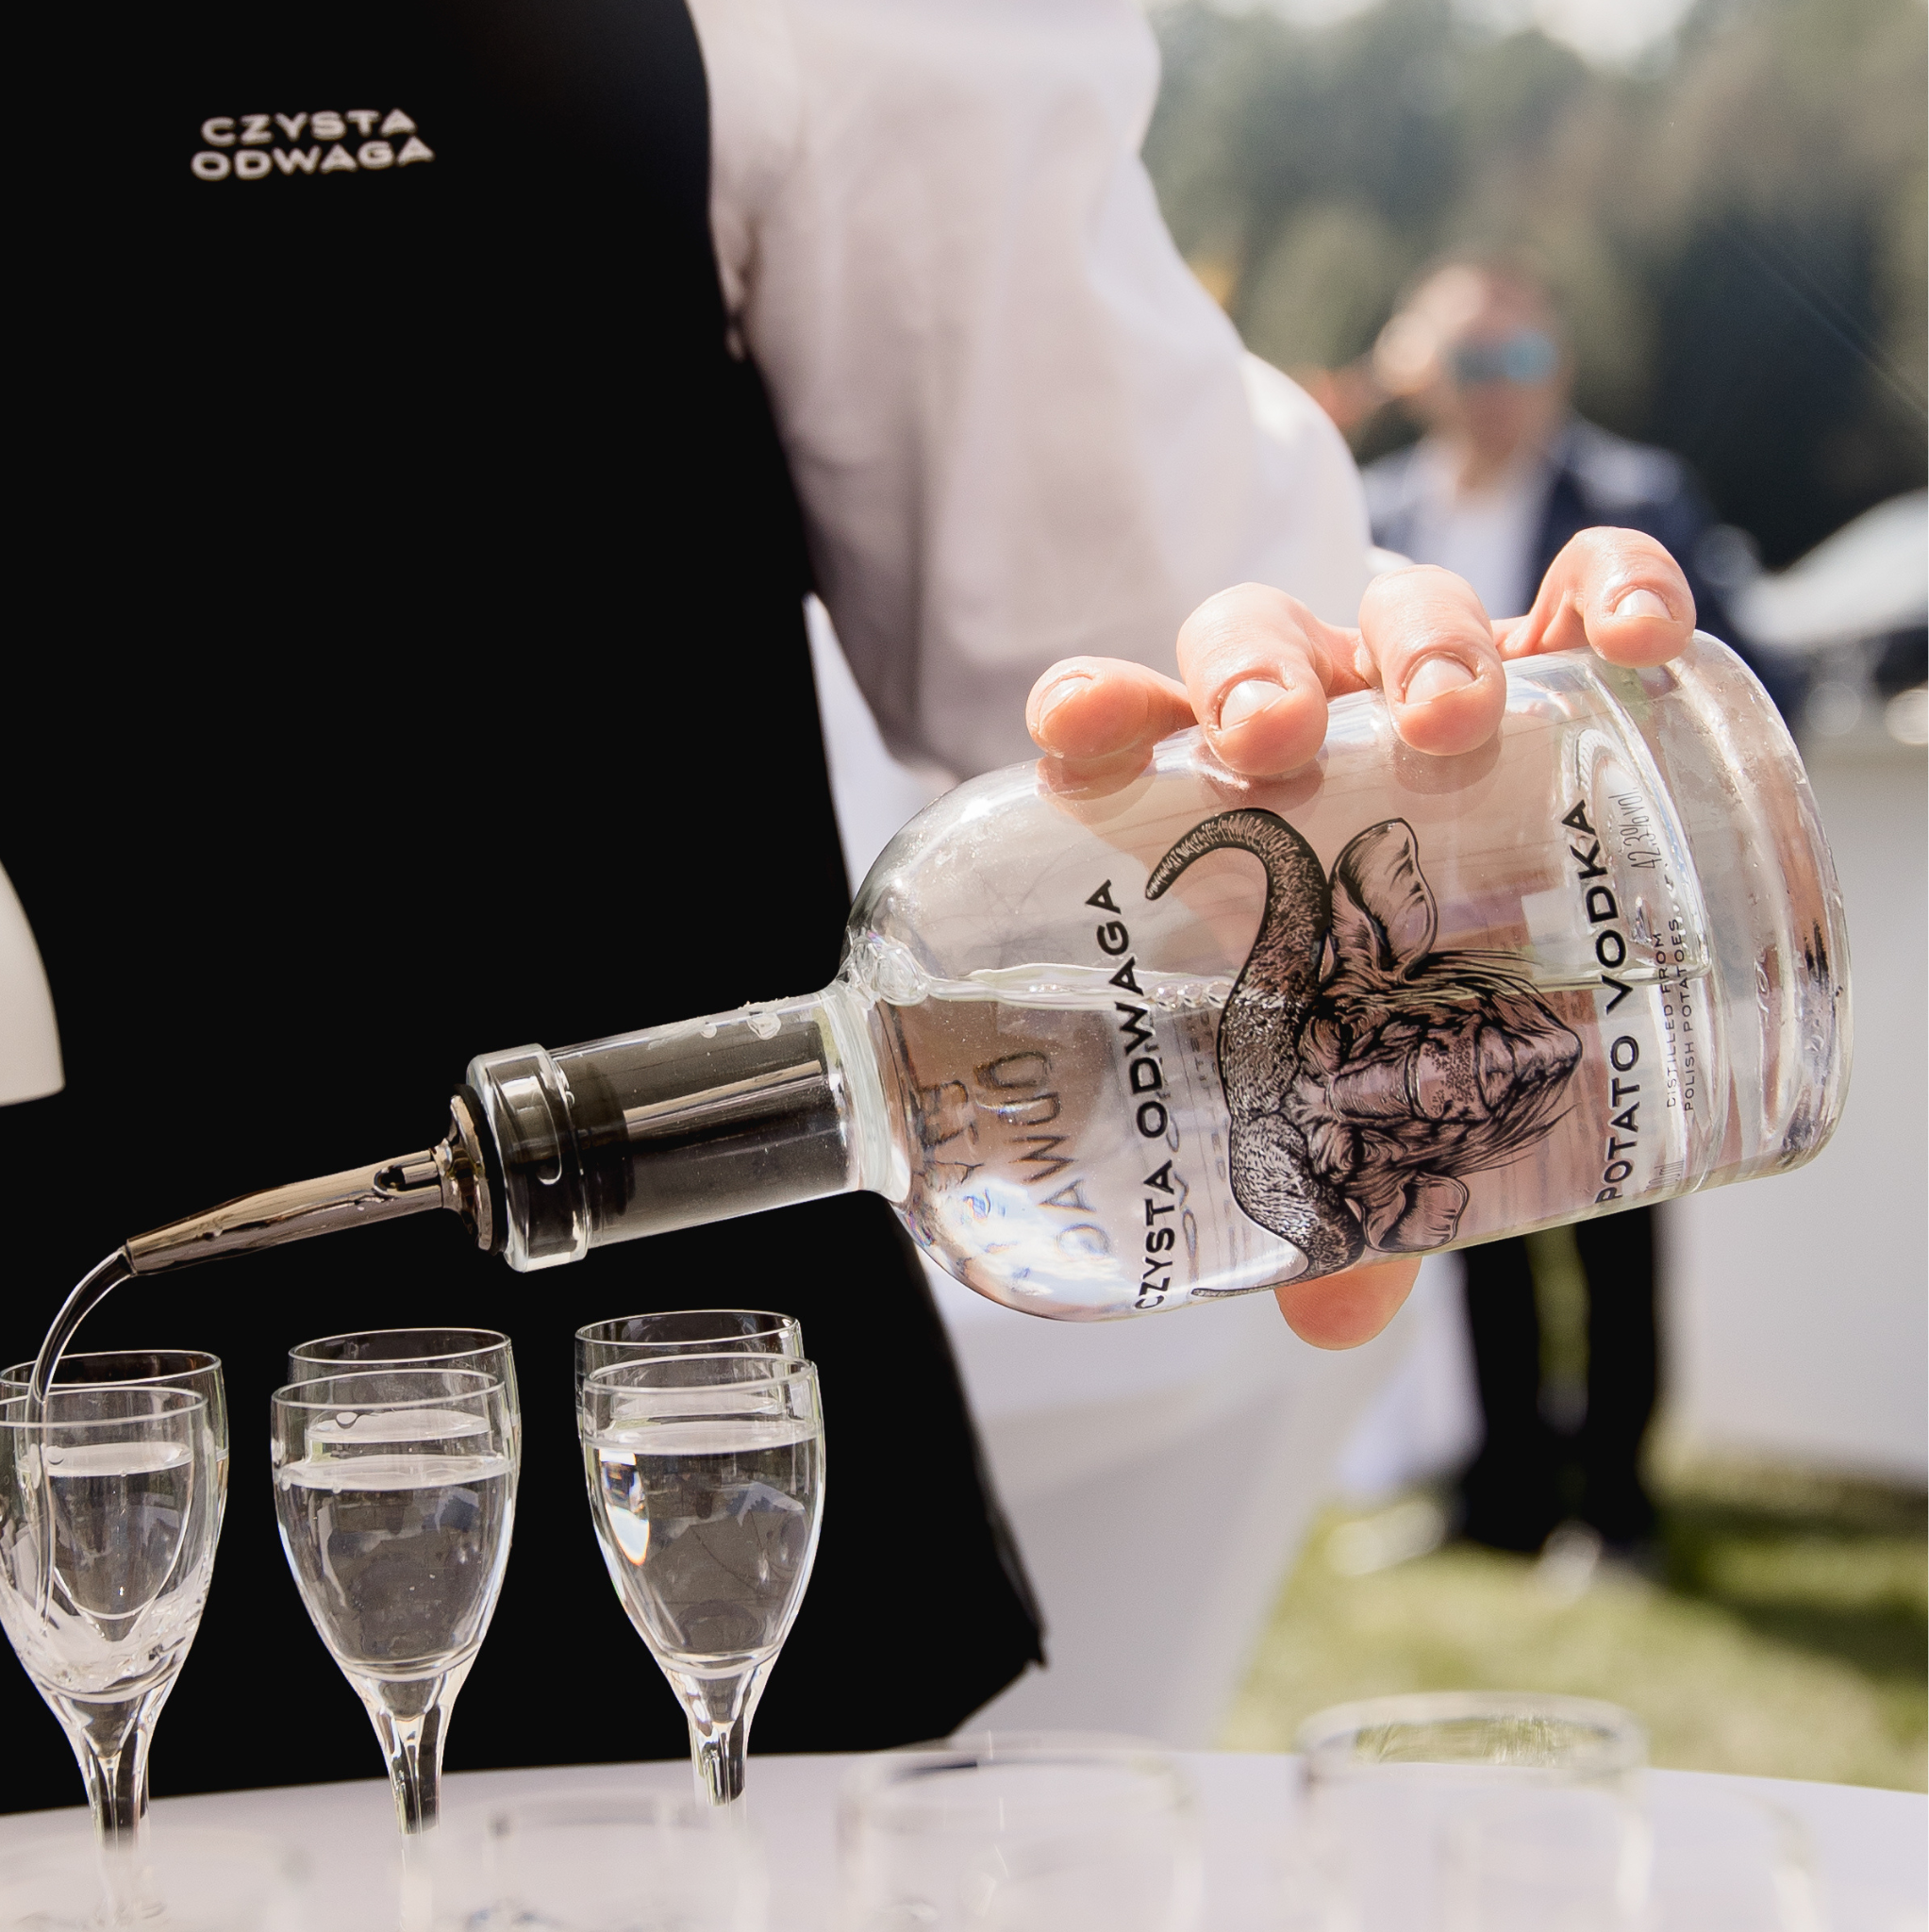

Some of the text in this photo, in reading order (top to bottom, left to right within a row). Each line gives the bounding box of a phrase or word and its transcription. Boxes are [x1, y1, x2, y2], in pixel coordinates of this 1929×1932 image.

[191, 135, 436, 181] ODWAGA
[201, 107, 417, 147] CZYSTA
[1561, 799, 1640, 1204] POTATO VODKA
[1653, 932, 1677, 1108] DISTILLED FROM
[1669, 918, 1695, 1111] POLISH POTATOES
[1085, 879, 1175, 1310] CZYSTA ODWAGA
